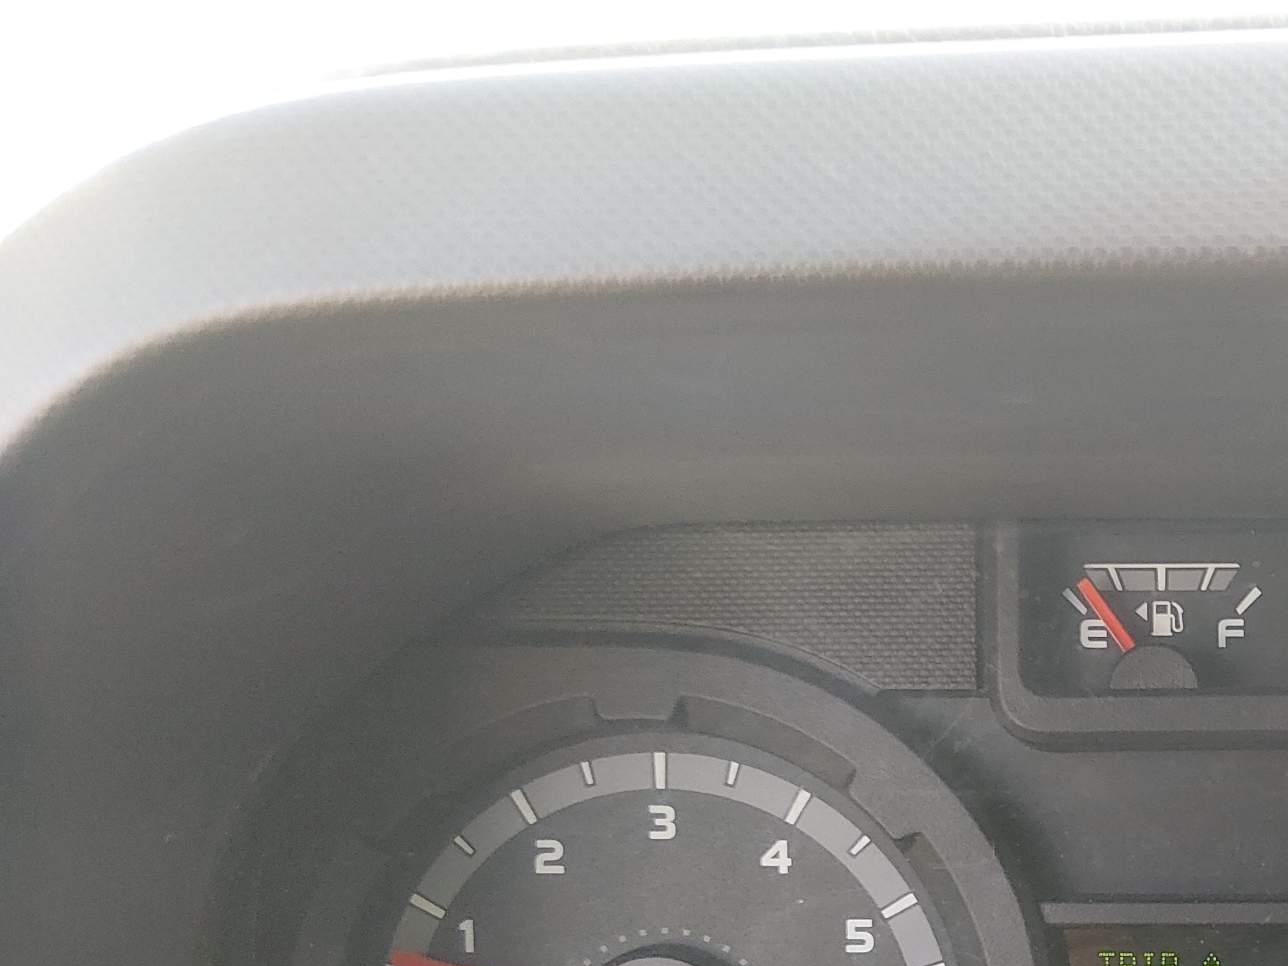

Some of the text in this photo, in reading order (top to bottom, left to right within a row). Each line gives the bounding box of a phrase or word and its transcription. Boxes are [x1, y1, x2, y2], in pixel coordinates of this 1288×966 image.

[1080, 619, 1108, 648] E
[1217, 618, 1245, 648] F
[647, 804, 676, 840] 3
[534, 839, 565, 874] 2
[759, 839, 792, 875] 4
[458, 919, 475, 953] 1
[845, 918, 875, 953] 5
